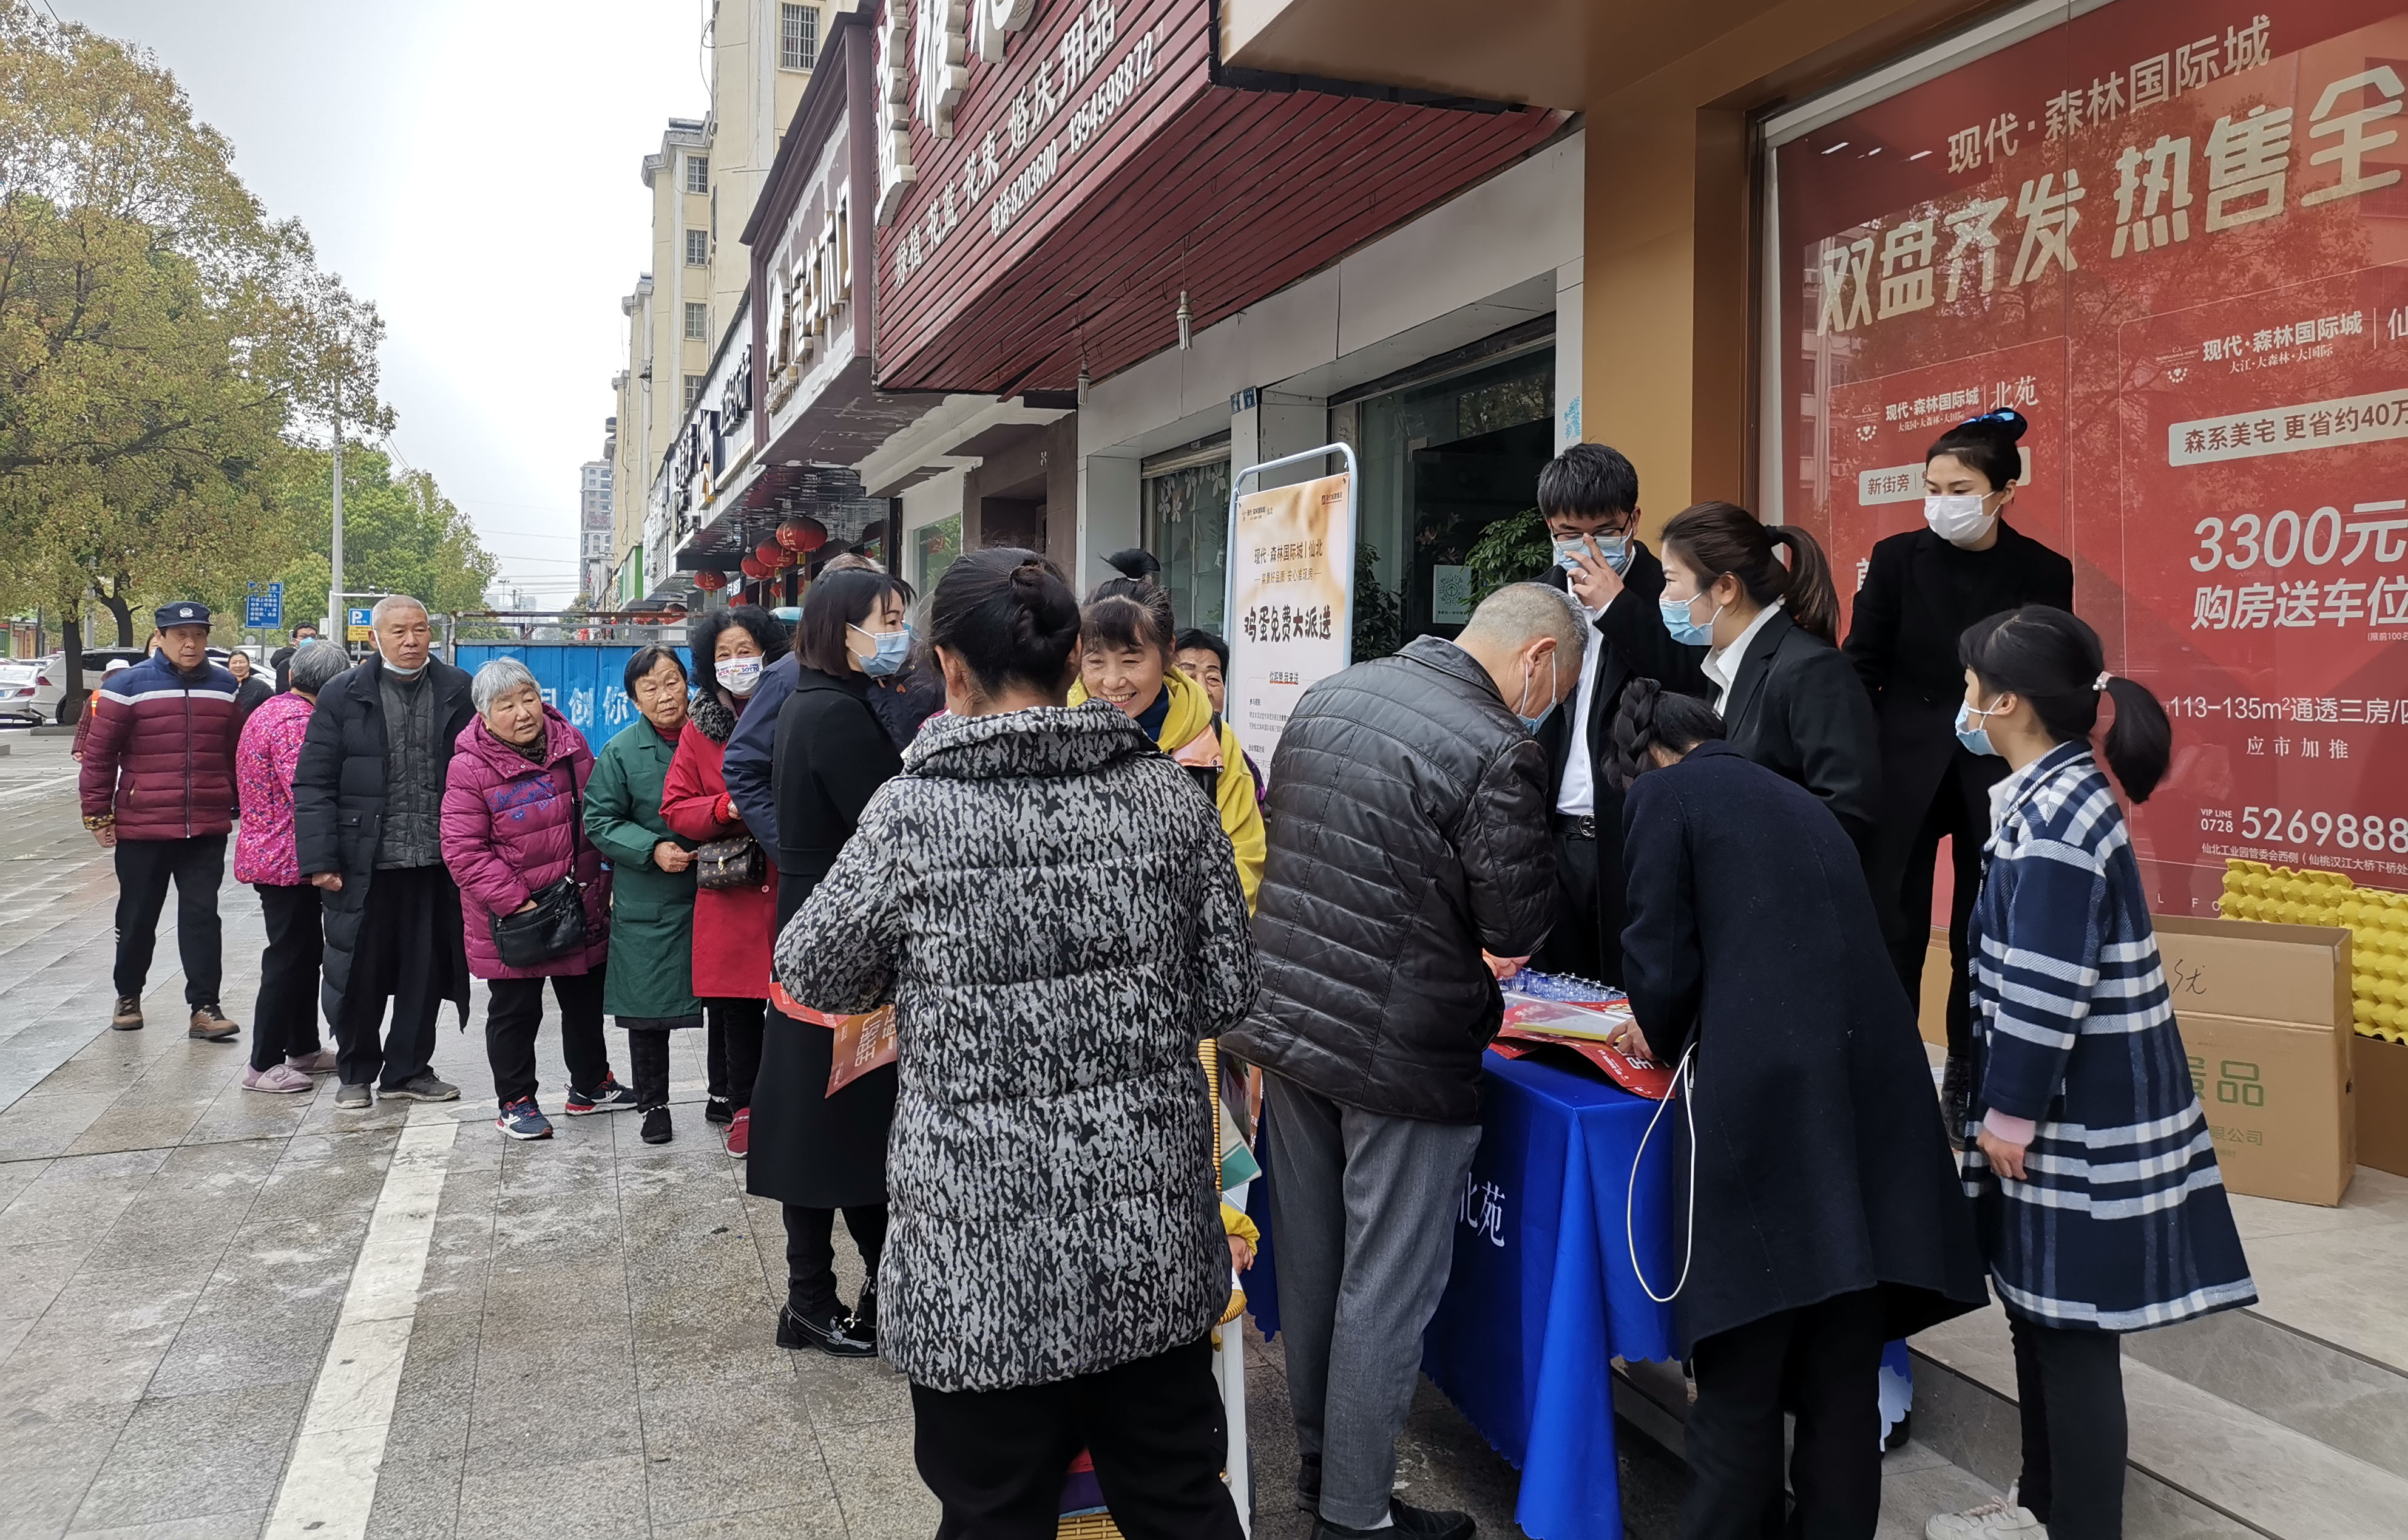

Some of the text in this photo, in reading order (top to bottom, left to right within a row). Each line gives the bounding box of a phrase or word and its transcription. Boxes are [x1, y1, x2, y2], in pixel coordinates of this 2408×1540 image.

[1948, 15, 2271, 175] 现代·森林国际城
[895, 0, 1115, 289] 绿植 花蓝 花束 婚庆用品
[1817, 66, 2407, 338] 双盘齐发 热售全
[2203, 310, 2362, 362] 现代·森林国际城
[1885, 375, 2039, 421] 现代·森林国际城 北苑
[2184, 399, 2408, 454] 森系美宅 更省约40万
[1867, 473, 1910, 495] 新街旁
[1254, 538, 1323, 565] 现代·森林国际城 仙北
[2189, 500, 2408, 572] 3300元
[1244, 603, 1331, 643] 鸡蛋免费大派送
[2191, 574, 2408, 631] 购房送车位
[2200, 808, 2233, 818] VIP LINE
[2200, 806, 2408, 853] 0728 5269888
